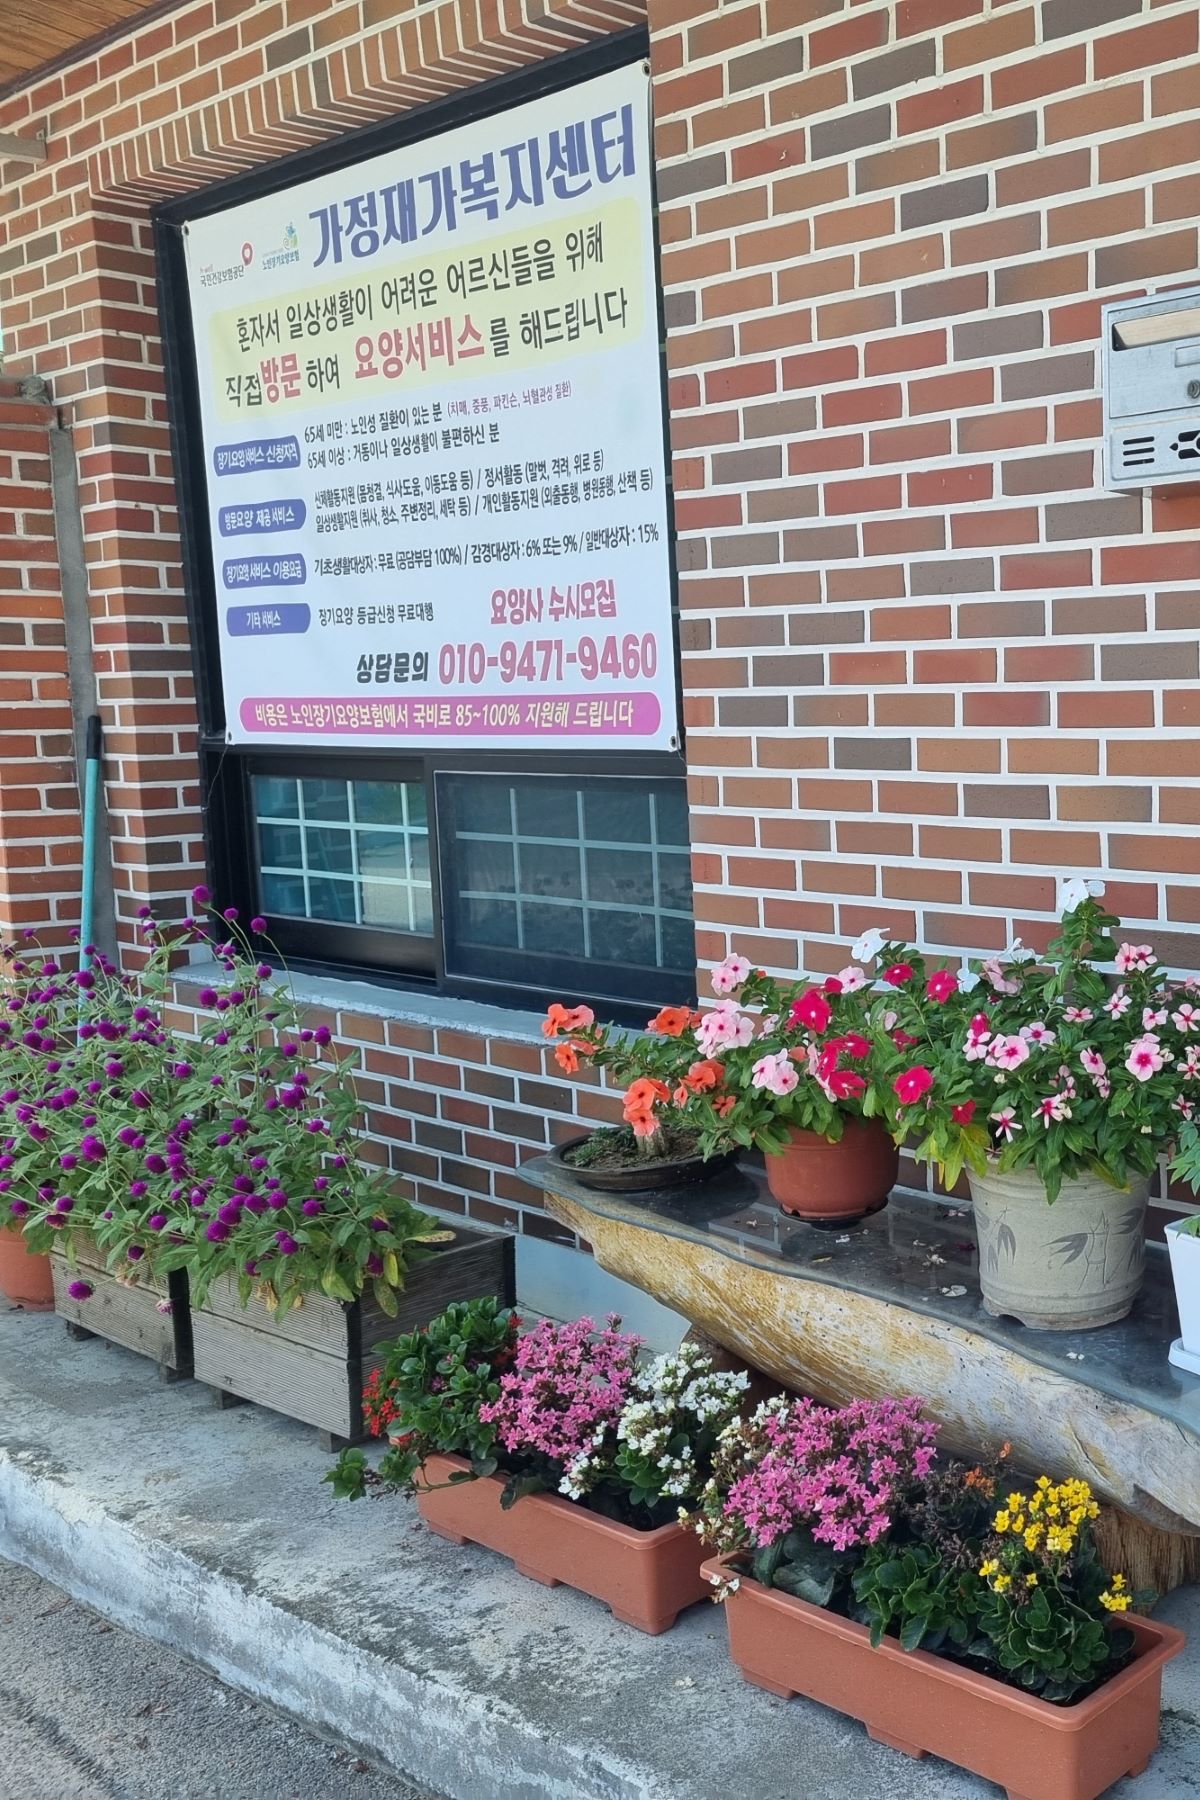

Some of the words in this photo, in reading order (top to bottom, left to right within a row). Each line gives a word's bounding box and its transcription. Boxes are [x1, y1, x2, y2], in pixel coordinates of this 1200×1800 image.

[309, 104, 636, 267] 가정재가복지센터
[200, 265, 244, 287] 국민건강보험공단
[236, 313, 280, 353] 혼자서
[286, 284, 373, 340] 일상생활이
[381, 268, 437, 316] 어려운
[446, 237, 556, 299] 어르신들을
[565, 222, 604, 271] 위해
[306, 354, 340, 394] 하여
[354, 314, 484, 380] 요양서비스
[489, 317, 510, 357] 를
[519, 287, 628, 351] 해드립니다
[304, 425, 324, 443] 65세
[326, 422, 343, 438] 미만
[350, 413, 375, 435] 노인성
[379, 408, 409, 432] 질환이
[412, 406, 429, 427] 있는
[432, 402, 442, 422] 분
[447, 401, 470, 418] (치매,
[472, 397, 492, 415] 중풍,
[493, 392, 521, 410] 파킨슨,
[522, 384, 553, 406] 뇌혈관성
[555, 380, 571, 398] 질환)
[266, 443, 298, 463] 신청자격
[307, 451, 325, 469] 65세
[329, 448, 345, 466] 이상
[353, 440, 388, 462] 거동이나
[391, 431, 438, 457] 일상생활이
[441, 425, 485, 449] 불편하신
[489, 423, 500, 443] 분
[315, 487, 355, 509] 신체활동지원
[386, 476, 423, 499] 식사도움,
[425, 471, 457, 495] 이동도움
[460, 469, 473, 490] 등)
[485, 463, 523, 487] 정서활동
[525, 460, 550, 484] (말벗,
[574, 451, 591, 475] 위로
[593, 449, 604, 472] 등)
[316, 512, 358, 533] 일상생활지원
[400, 502, 438, 523] 주변정리,
[439, 498, 455, 518] 세탁
[458, 496, 471, 517] 등)
[482, 487, 539, 513] 개인활동지원
[618, 470, 637, 493] 산책
[640, 467, 653, 491] 등)
[224, 511, 253, 529] 방문요양
[256, 510, 270, 526] 제공
[272, 507, 295, 524] 서비스
[273, 560, 301, 580] 이용요금
[378, 553, 395, 572] 무료
[435, 544, 462, 566] 100%)
[542, 536, 561, 556] 또는
[563, 535, 577, 554] 9%
[585, 524, 630, 551] 일반대상자
[638, 522, 659, 543] 15%
[246, 612, 260, 630] 기타
[262, 611, 281, 629] 서비스
[319, 609, 353, 627] 장기요양
[357, 605, 395, 625] 등급신청
[397, 602, 434, 622] 무료대행
[491, 587, 543, 625] 요양사
[549, 579, 617, 623] 수시모집
[356, 652, 429, 683] 상담문의
[439, 632, 657, 685] 010-9471-9460
[255, 704, 288, 726] 비용은
[290, 704, 408, 728] 노인장기요양보험에서
[413, 704, 451, 728] 국비로
[455, 703, 520, 727] 85~100%
[525, 702, 569, 728] 지원해
[573, 700, 634, 727] 드립니다
